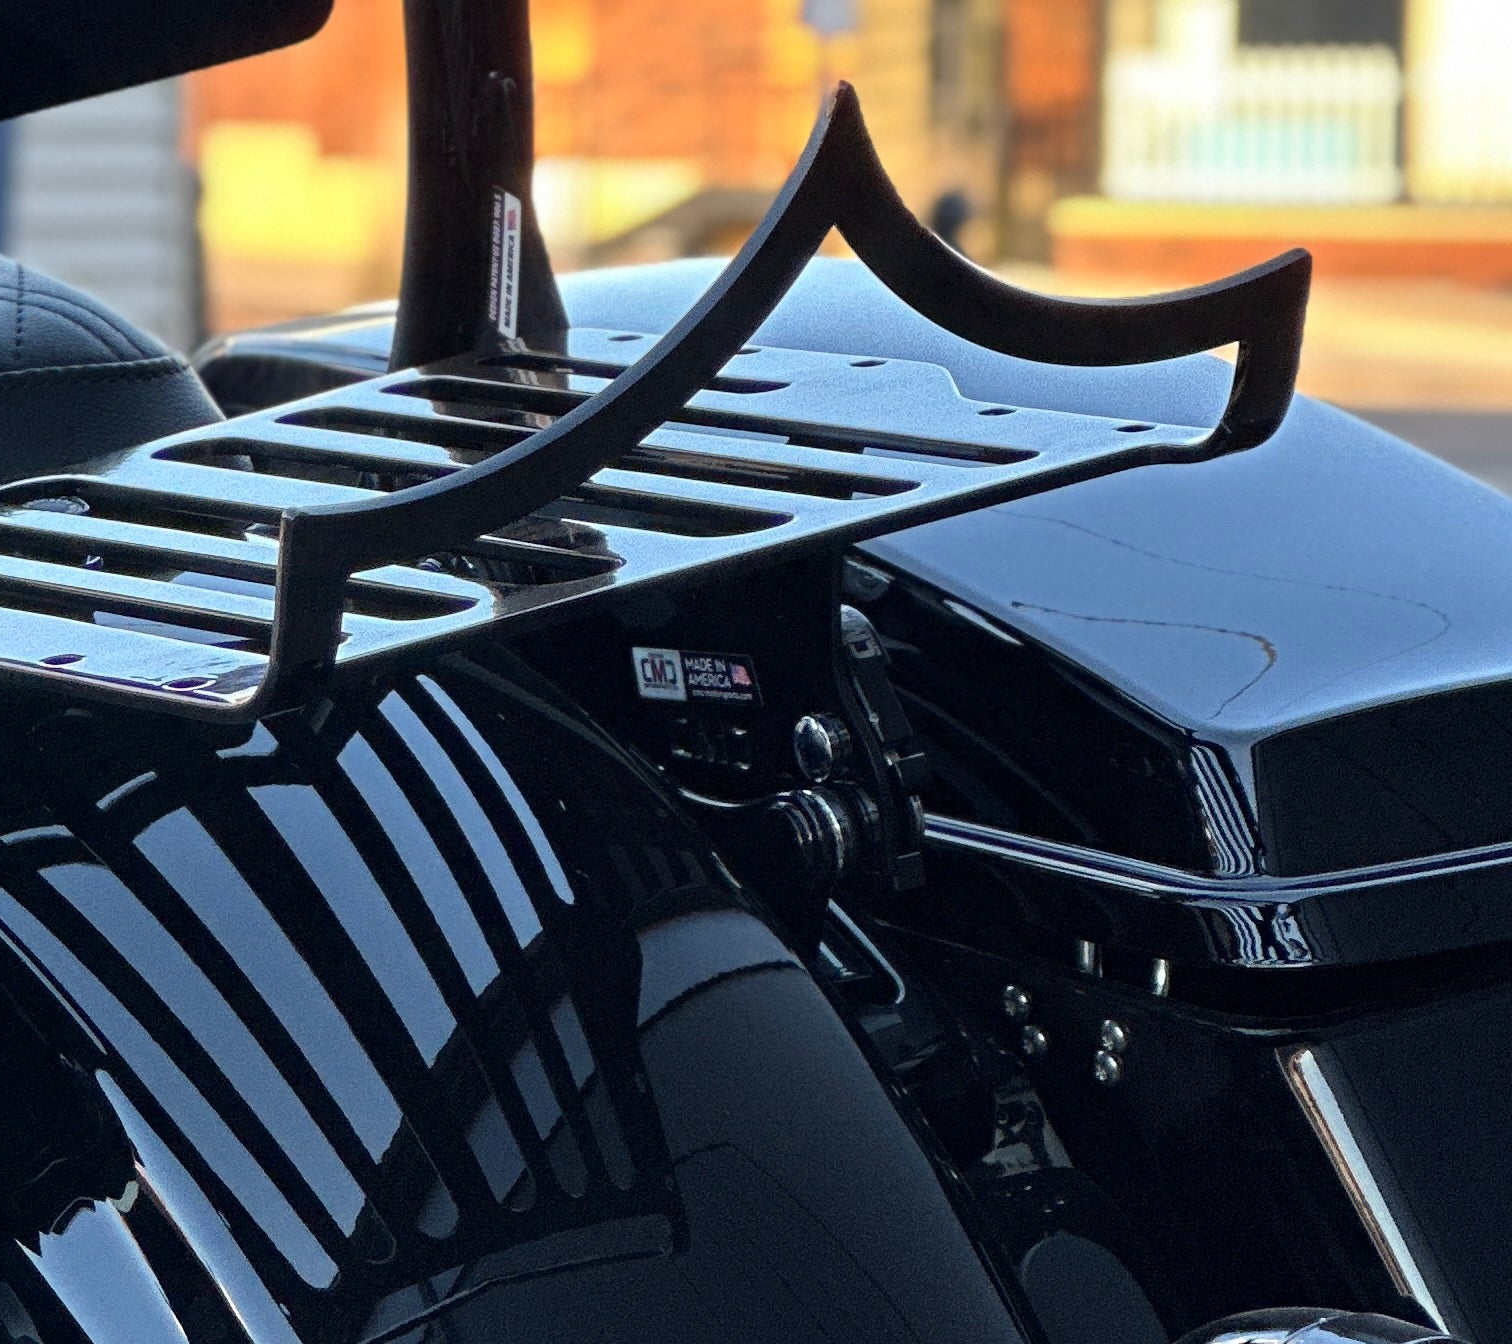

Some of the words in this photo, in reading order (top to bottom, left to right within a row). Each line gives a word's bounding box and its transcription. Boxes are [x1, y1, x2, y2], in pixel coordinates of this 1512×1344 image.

[506, 235, 514, 281] AMERICA
[505, 281, 514, 297] IN
[684, 657, 713, 673] MADE
[715, 659, 727, 673] IN
[687, 672, 732, 689] AMERICA
